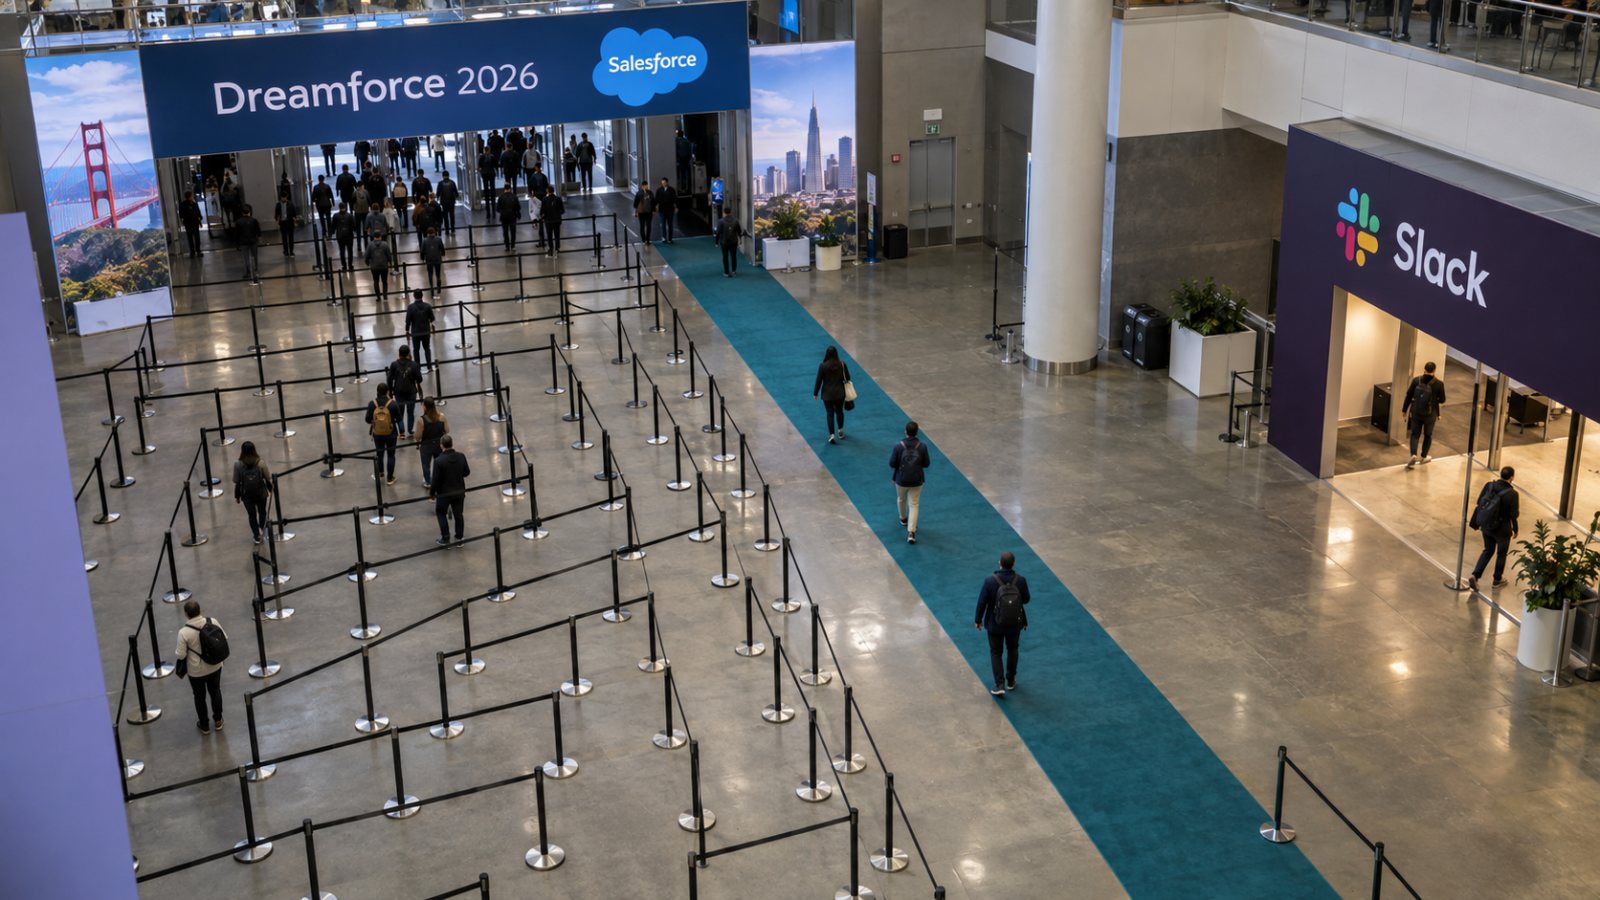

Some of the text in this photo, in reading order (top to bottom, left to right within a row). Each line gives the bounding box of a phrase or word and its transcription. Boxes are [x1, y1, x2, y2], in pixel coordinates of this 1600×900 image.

[214, 62, 539, 115] Dreamforce 2026
[608, 52, 698, 76] Salesforce
[1393, 222, 1491, 308] Slack
